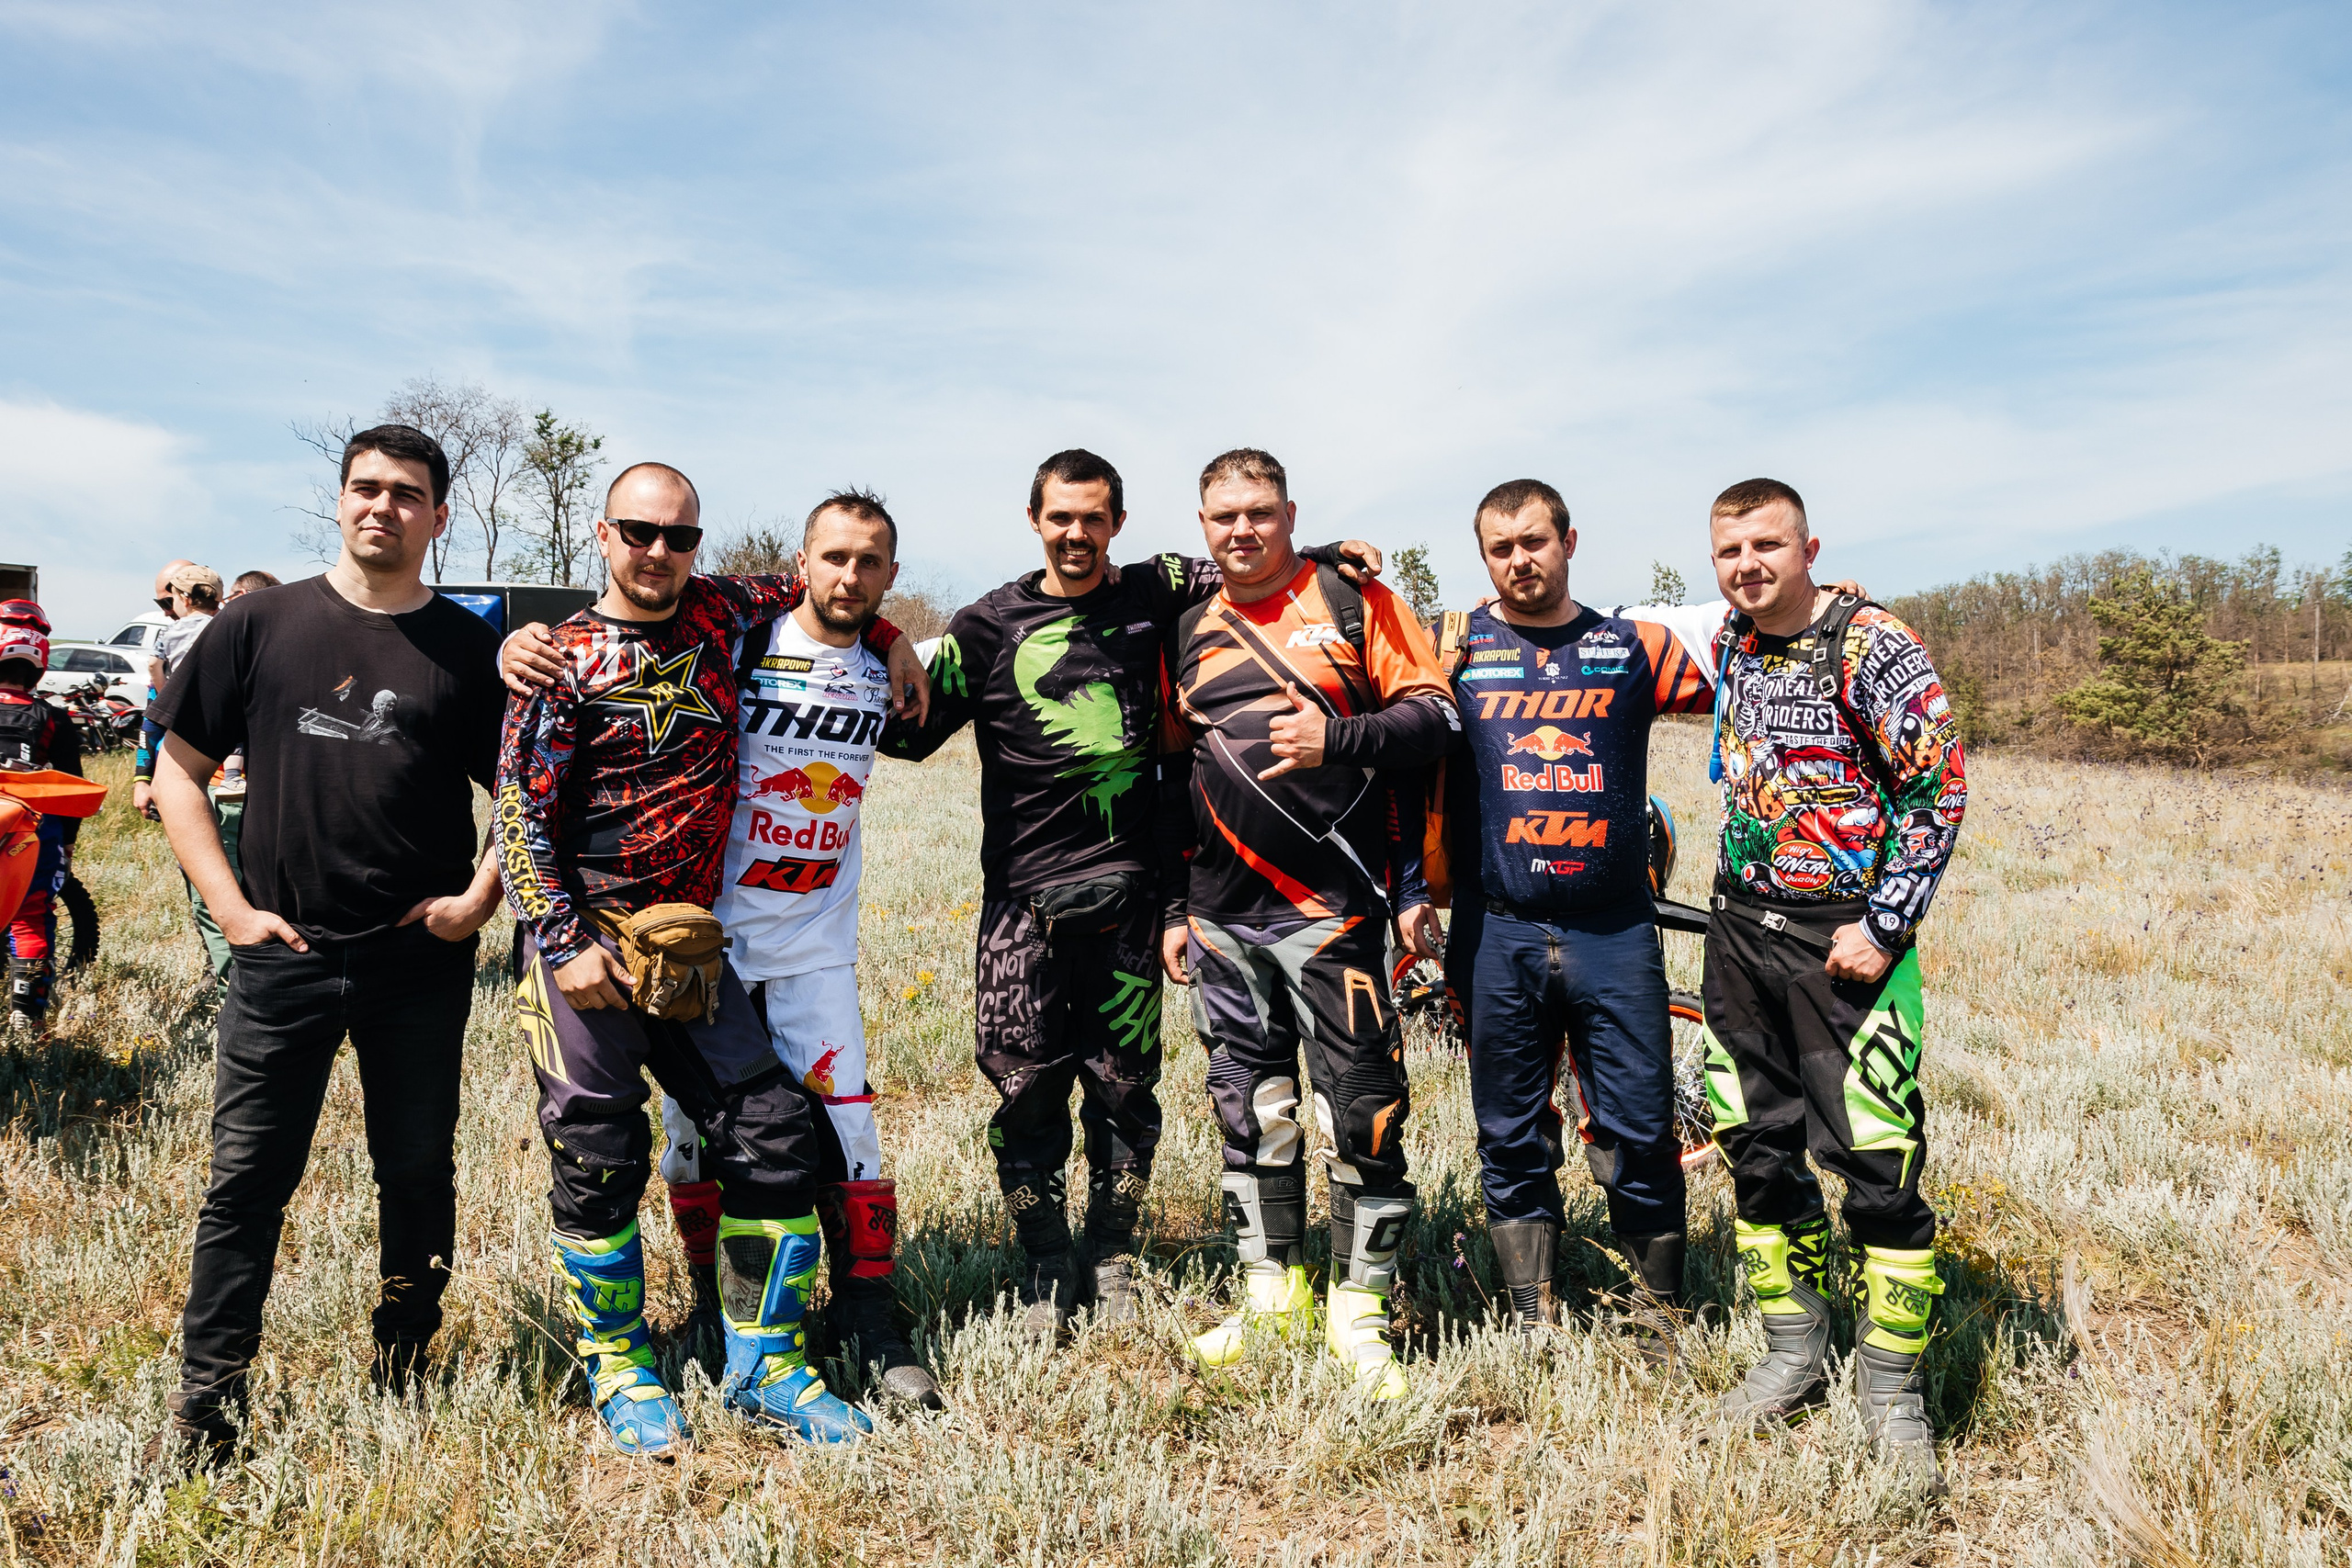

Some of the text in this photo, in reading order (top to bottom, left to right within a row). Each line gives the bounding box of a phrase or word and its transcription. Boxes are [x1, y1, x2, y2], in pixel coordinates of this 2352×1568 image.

[1285, 623, 1348, 649] KTM
[751, 676, 803, 690] OTOREX
[1471, 668, 1522, 679] MOTOREX
[1765, 676, 1817, 699] O'NEAL
[1476, 688, 1616, 720] THOR
[741, 697, 884, 747] THOR
[764, 744, 870, 762] THE FIRST THE FOREVER
[1501, 763, 1604, 793] Red Bull
[494, 802, 506, 863] ENERGY
[748, 809, 819, 851] Red
[1505, 809, 1609, 848] KTM
[1531, 858, 1586, 875] MXGP
[1772, 855, 1831, 875] O'NEAL
[1883, 916, 1896, 927] 19
[992, 945, 1034, 987] NOT
[1012, 1013, 1046, 1040] OVER
[1019, 1032, 1046, 1053] THE
